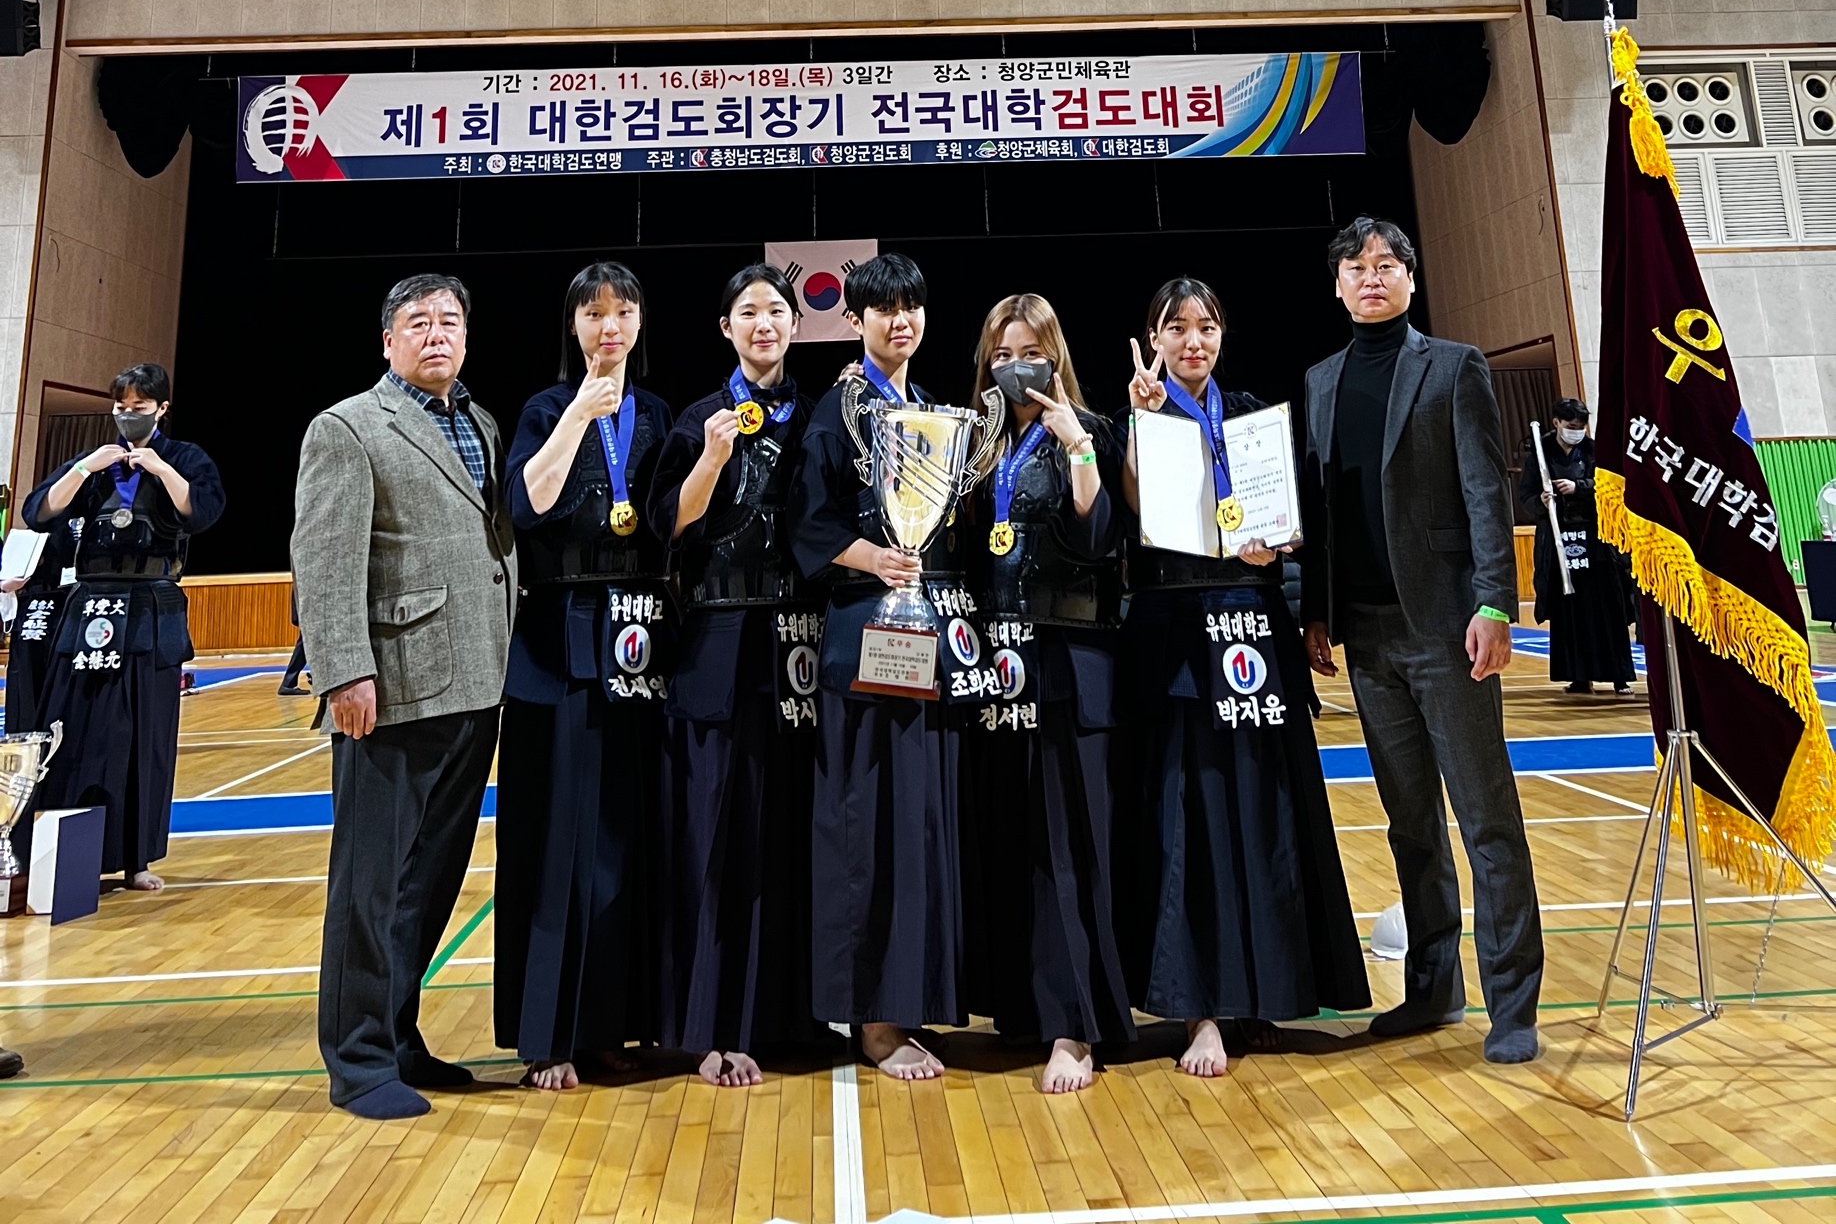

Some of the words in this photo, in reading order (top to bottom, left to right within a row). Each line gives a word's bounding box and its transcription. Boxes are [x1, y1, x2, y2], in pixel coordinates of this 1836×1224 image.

[482, 74, 522, 94] 기간
[549, 73, 607, 92] 2021.
[617, 72, 648, 90] 11.
[842, 65, 893, 85] 3일간
[933, 64, 971, 83] 장소
[997, 60, 1131, 82] 청양군민체육관
[380, 102, 500, 148] 제1회
[528, 93, 844, 144] 대한검도회장기
[870, 84, 1225, 135] 전국대학검도대회
[443, 156, 472, 174] 주최
[508, 151, 623, 173] 한국대학검도연맹
[646, 150, 675, 169] 주관
[709, 146, 805, 167] 충청남도검도회,
[830, 143, 912, 164] 청양군검도회
[935, 142, 962, 160] 후원
[997, 139, 1078, 159] 청양군체육회,
[1102, 137, 1171, 156] 대한검도회
[610, 593, 664, 625] 유원대학교
[933, 588, 978, 616] 유원대학교
[983, 621, 1035, 647] 원대학교
[1205, 610, 1272, 643] 유원대학교
[950, 667, 1003, 698] 조희선
[979, 701, 1038, 731] 정서현
[1215, 693, 1287, 729] 박지윤
